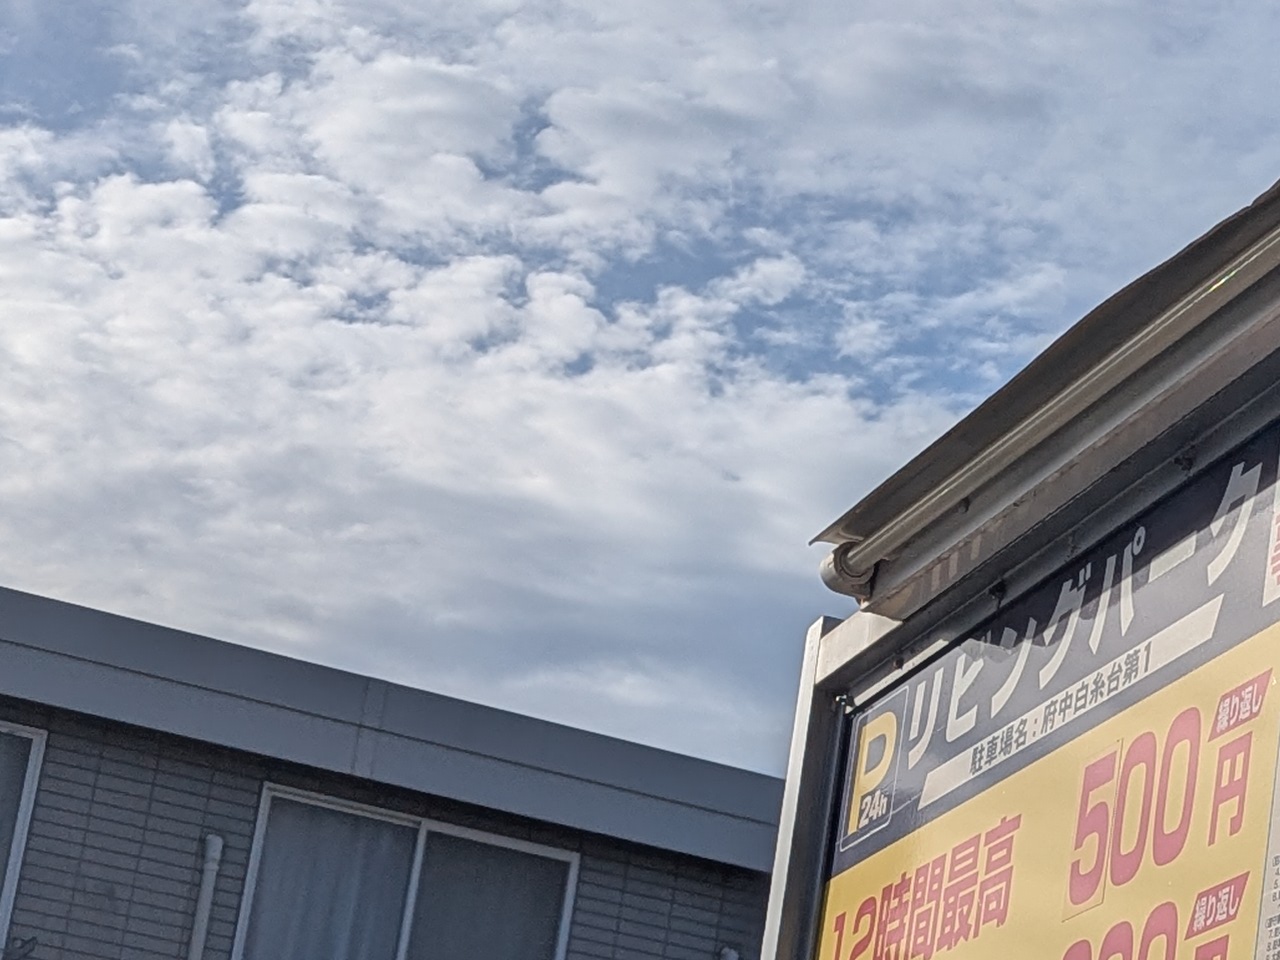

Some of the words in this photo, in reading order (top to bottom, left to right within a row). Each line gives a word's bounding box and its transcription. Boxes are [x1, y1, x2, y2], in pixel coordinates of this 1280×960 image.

[908, 462, 1263, 770] リビングパーク
[1217, 683, 1262, 733] 繰り返し
[848, 711, 897, 835] P
[858, 789, 888, 828] 24h
[1068, 707, 1253, 905] 500円
[1193, 884, 1239, 932] 繰り返し
